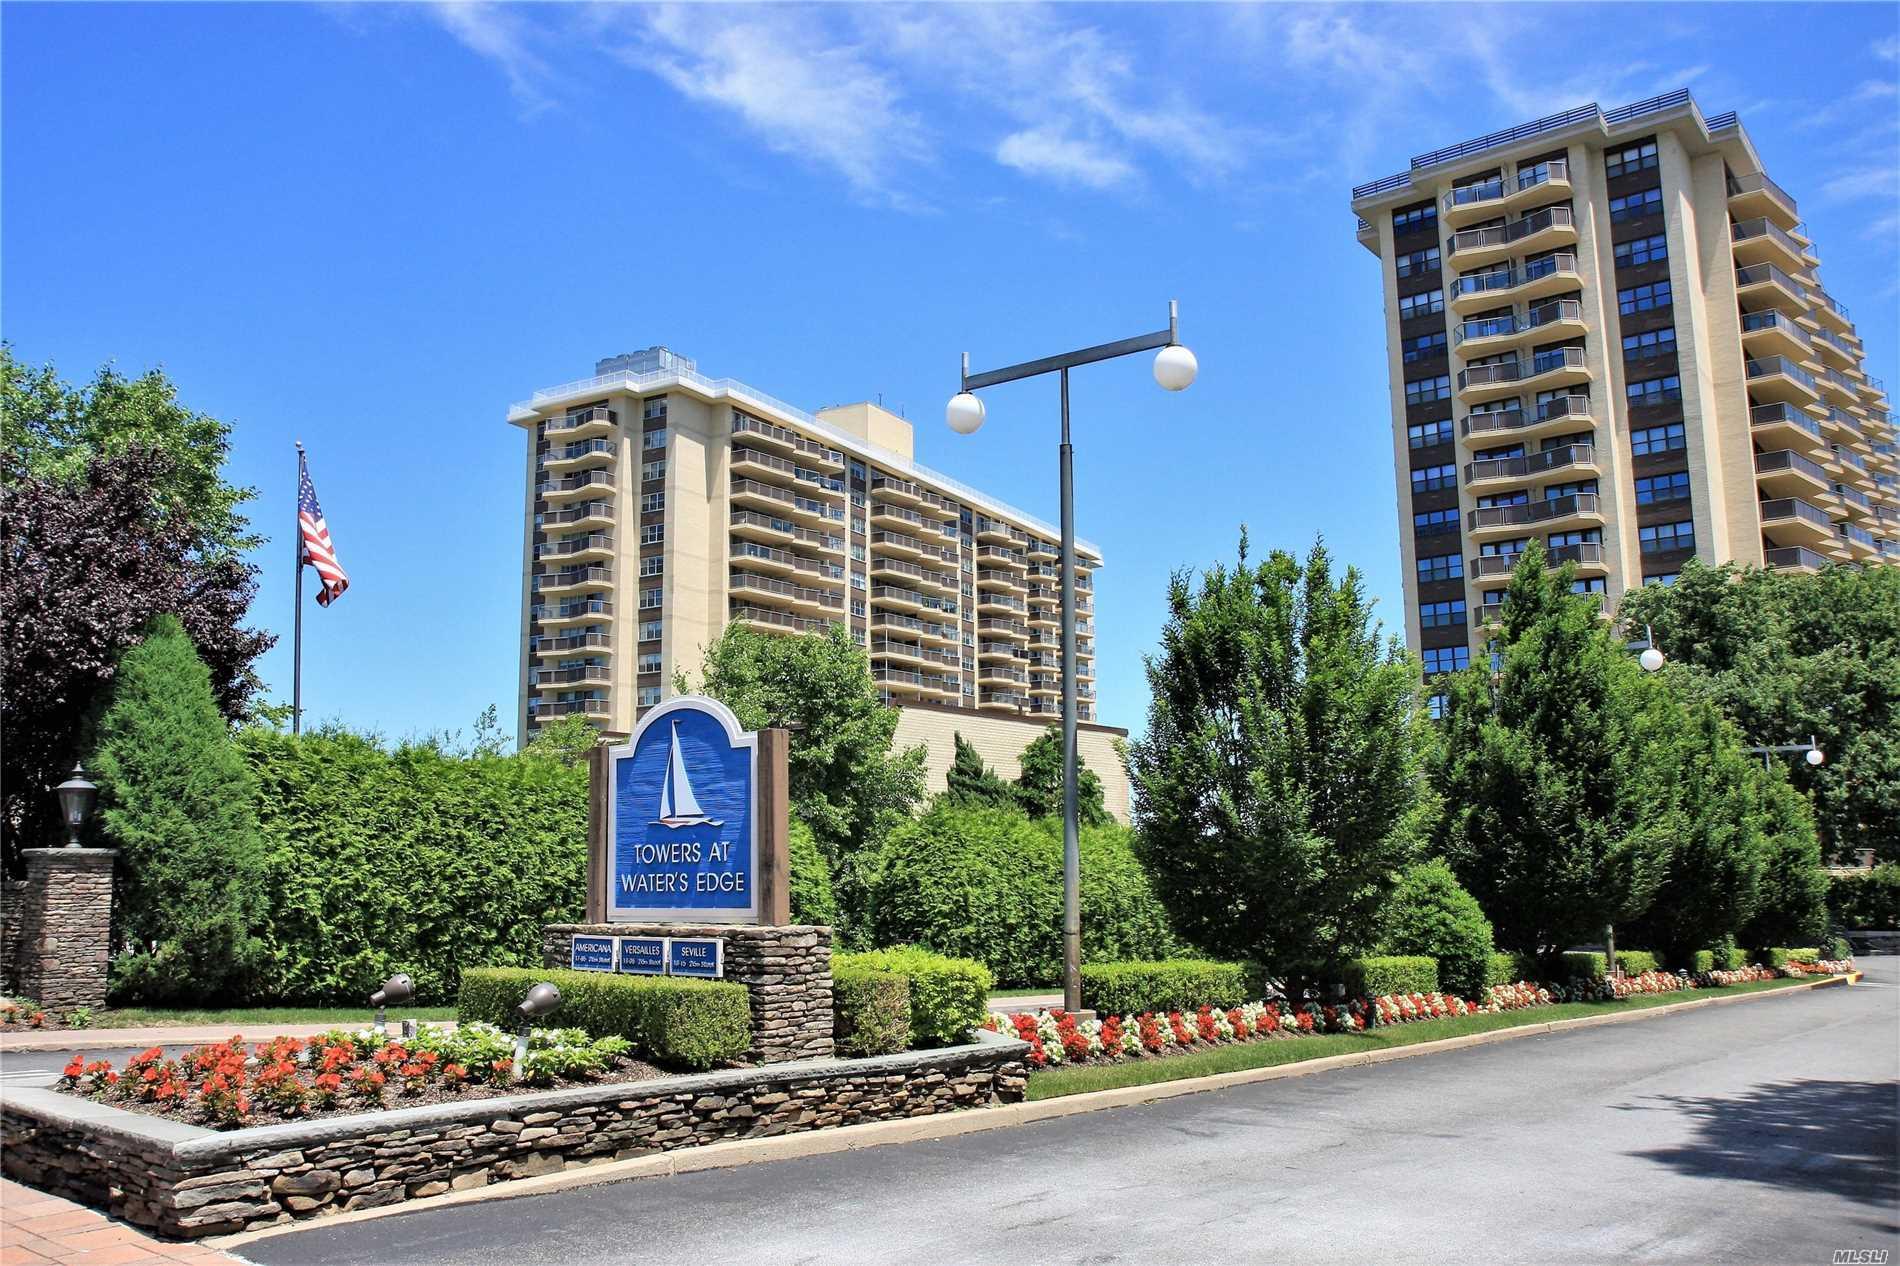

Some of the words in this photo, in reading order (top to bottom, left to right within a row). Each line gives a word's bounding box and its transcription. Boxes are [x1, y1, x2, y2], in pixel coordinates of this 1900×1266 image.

[634, 842, 701, 864] TOWERS
[709, 841, 730, 862] AT
[621, 871, 689, 892] WATER'S
[696, 871, 744, 892] EDGE
[574, 943, 612, 953] AMERICANA
[624, 945, 660, 956] VERSAILLES
[681, 946, 707, 957] SEVILLE
